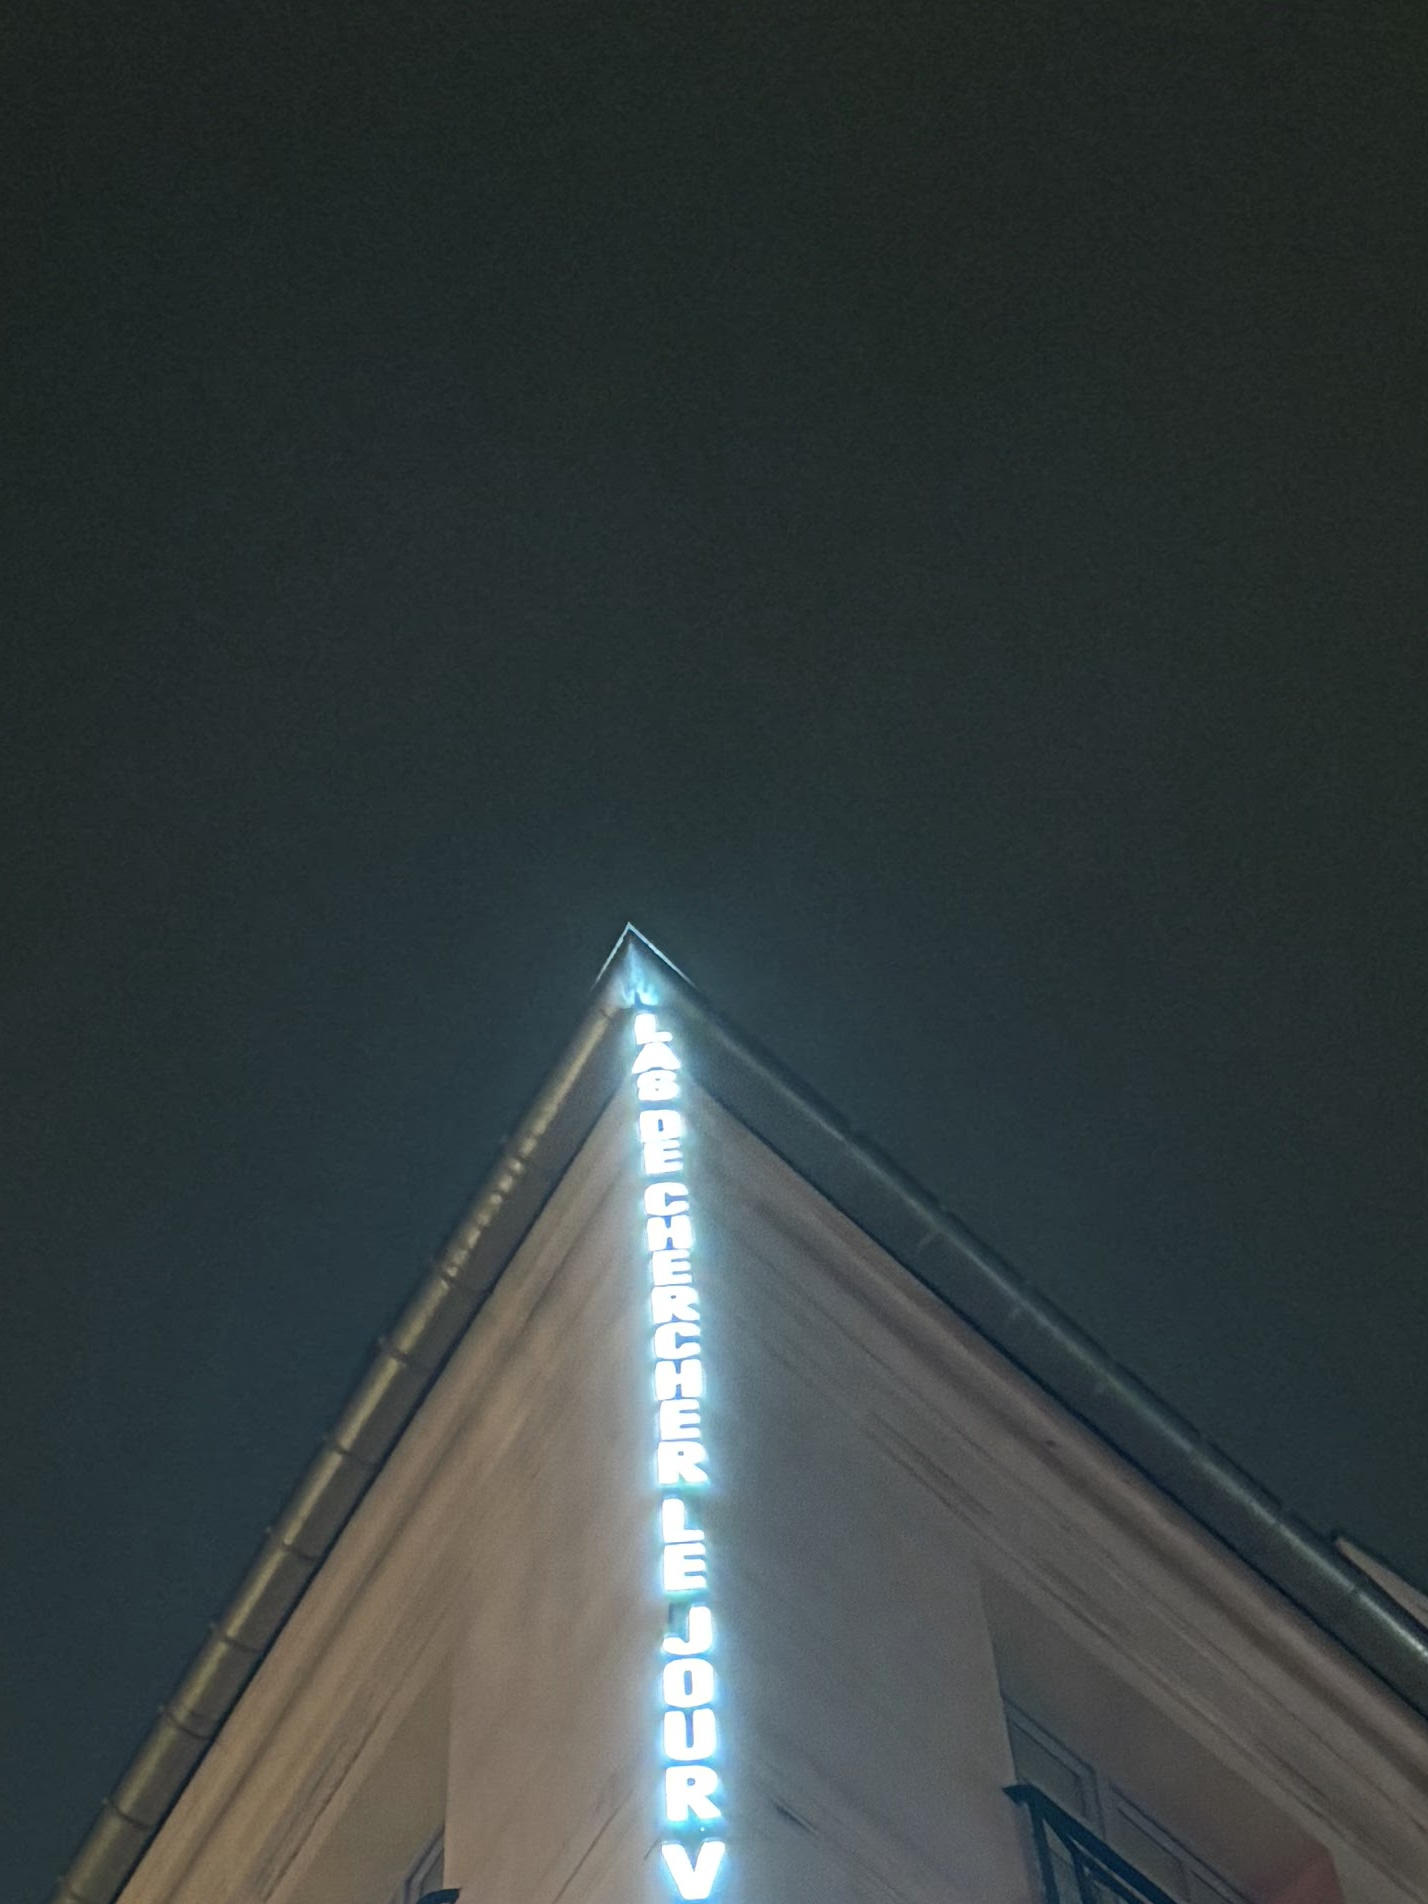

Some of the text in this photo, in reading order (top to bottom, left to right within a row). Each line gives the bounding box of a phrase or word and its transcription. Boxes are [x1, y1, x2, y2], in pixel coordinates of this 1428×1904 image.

[638, 1109, 683, 1174] DE
[643, 1182, 707, 1485] CHERCHER
[661, 1498, 707, 1591] LE
[662, 1605, 721, 1822] JOUR
